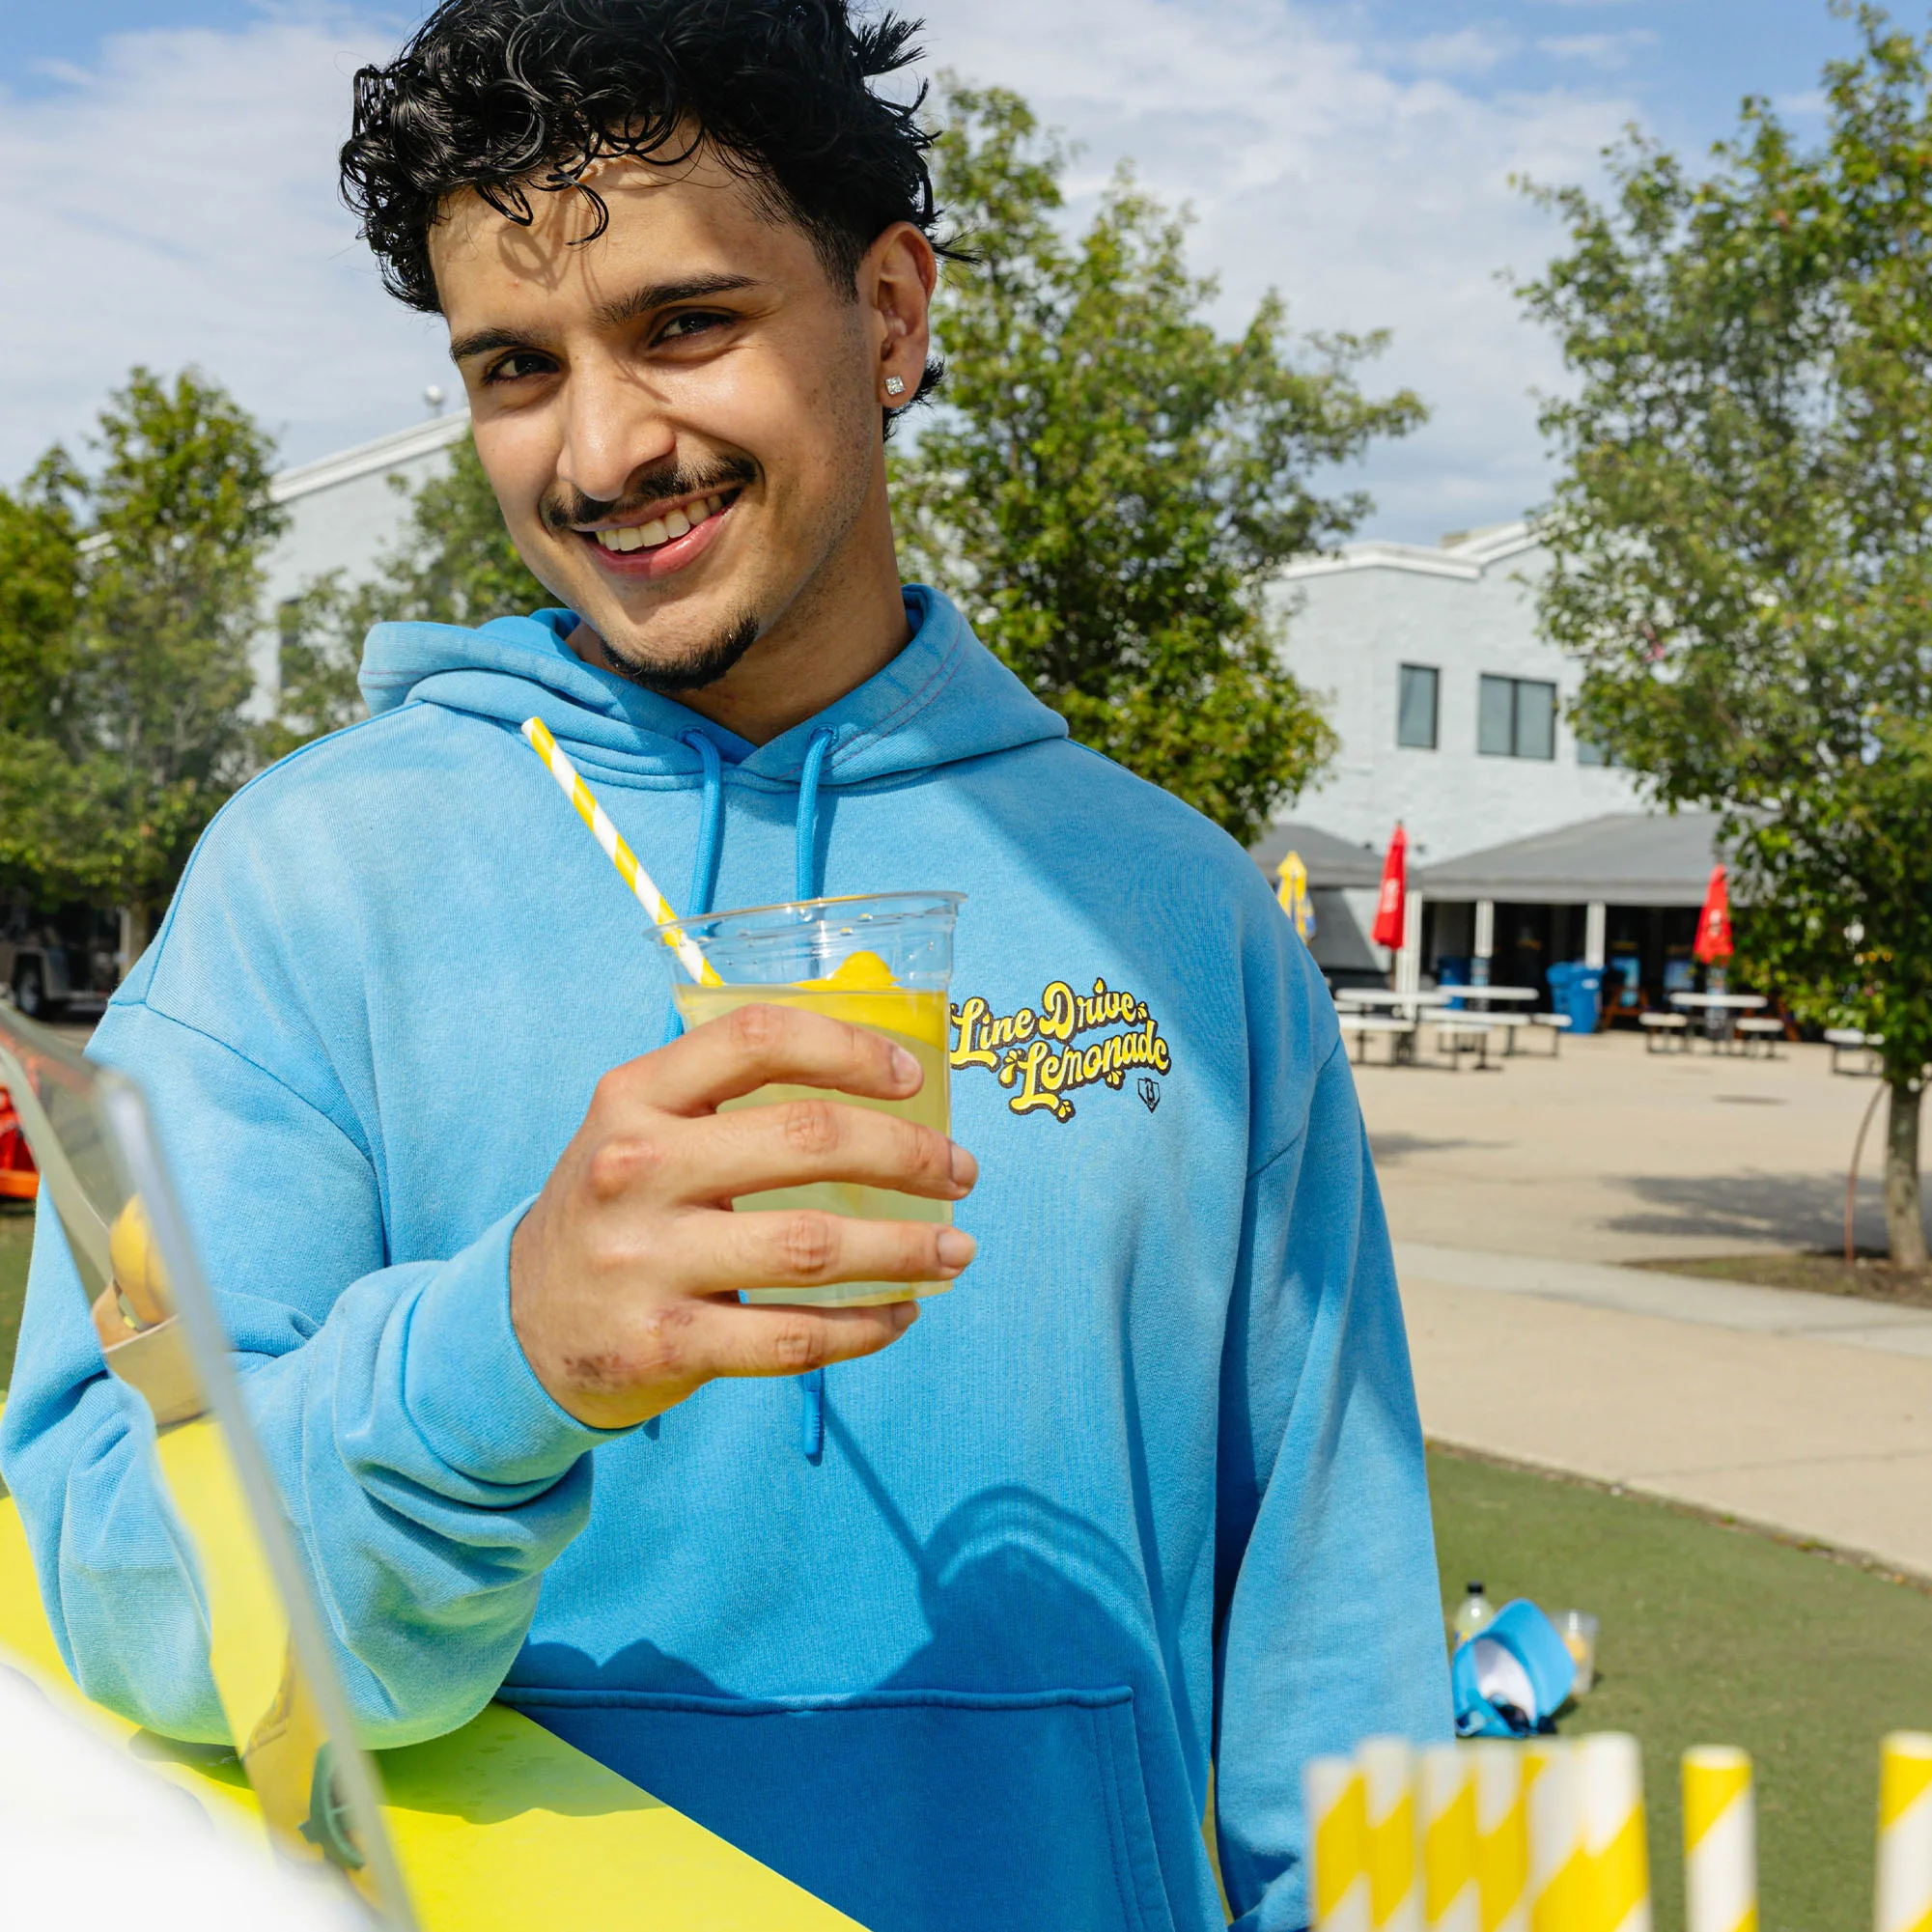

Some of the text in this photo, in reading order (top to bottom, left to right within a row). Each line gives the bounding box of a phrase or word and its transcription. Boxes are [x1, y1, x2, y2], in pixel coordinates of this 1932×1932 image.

[951, 977, 1137, 1072] Line Drive
[1009, 1021, 1171, 1115] Lemonade
